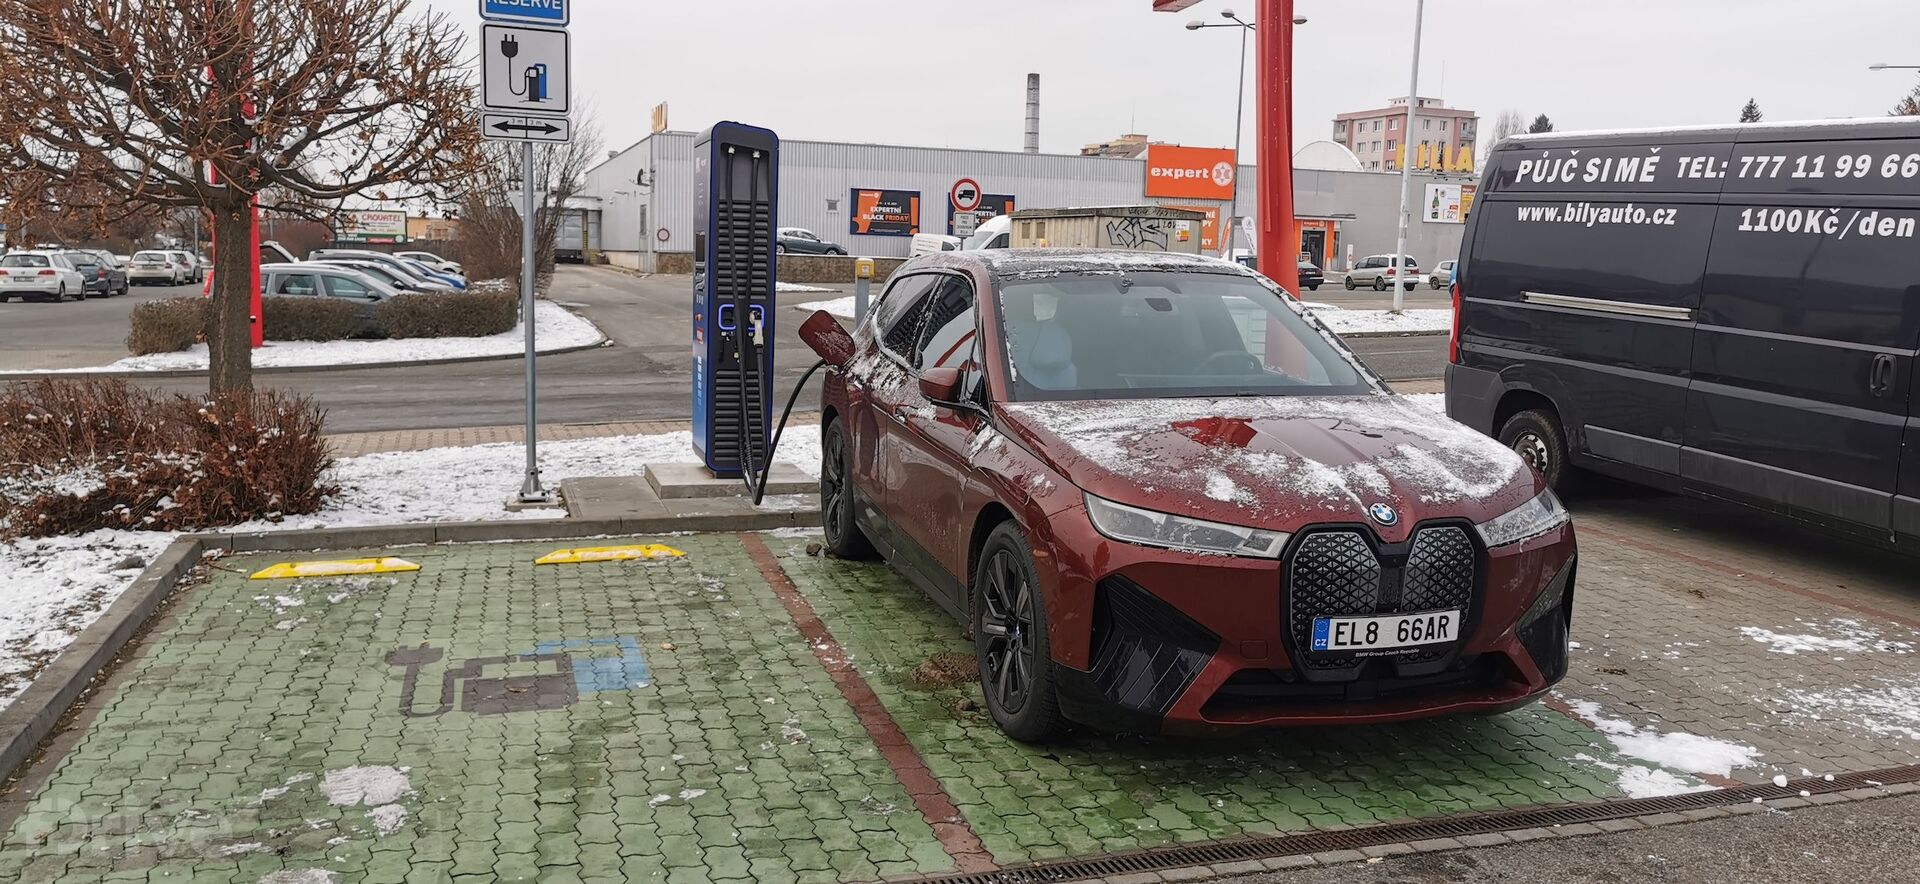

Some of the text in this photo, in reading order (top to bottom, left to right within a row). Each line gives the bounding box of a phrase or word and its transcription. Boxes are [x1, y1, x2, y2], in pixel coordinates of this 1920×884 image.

[487, 0, 562, 10] ERVE
[1515, 150, 1580, 183] PŮJČ
[1677, 156, 1728, 178] TEL:
[1738, 155, 1786, 178] 777
[1791, 155, 1826, 178] 11
[1834, 154, 1872, 178] 99
[1880, 153, 1920, 178] 66
[1150, 167, 1209, 179] expert
[870, 206, 902, 214] EXPERTNÍ
[1517, 202, 1678, 228] www.bilyauto.cz
[1334, 615, 1450, 647] EL8 66AR
[1314, 638, 1327, 647] CZ
